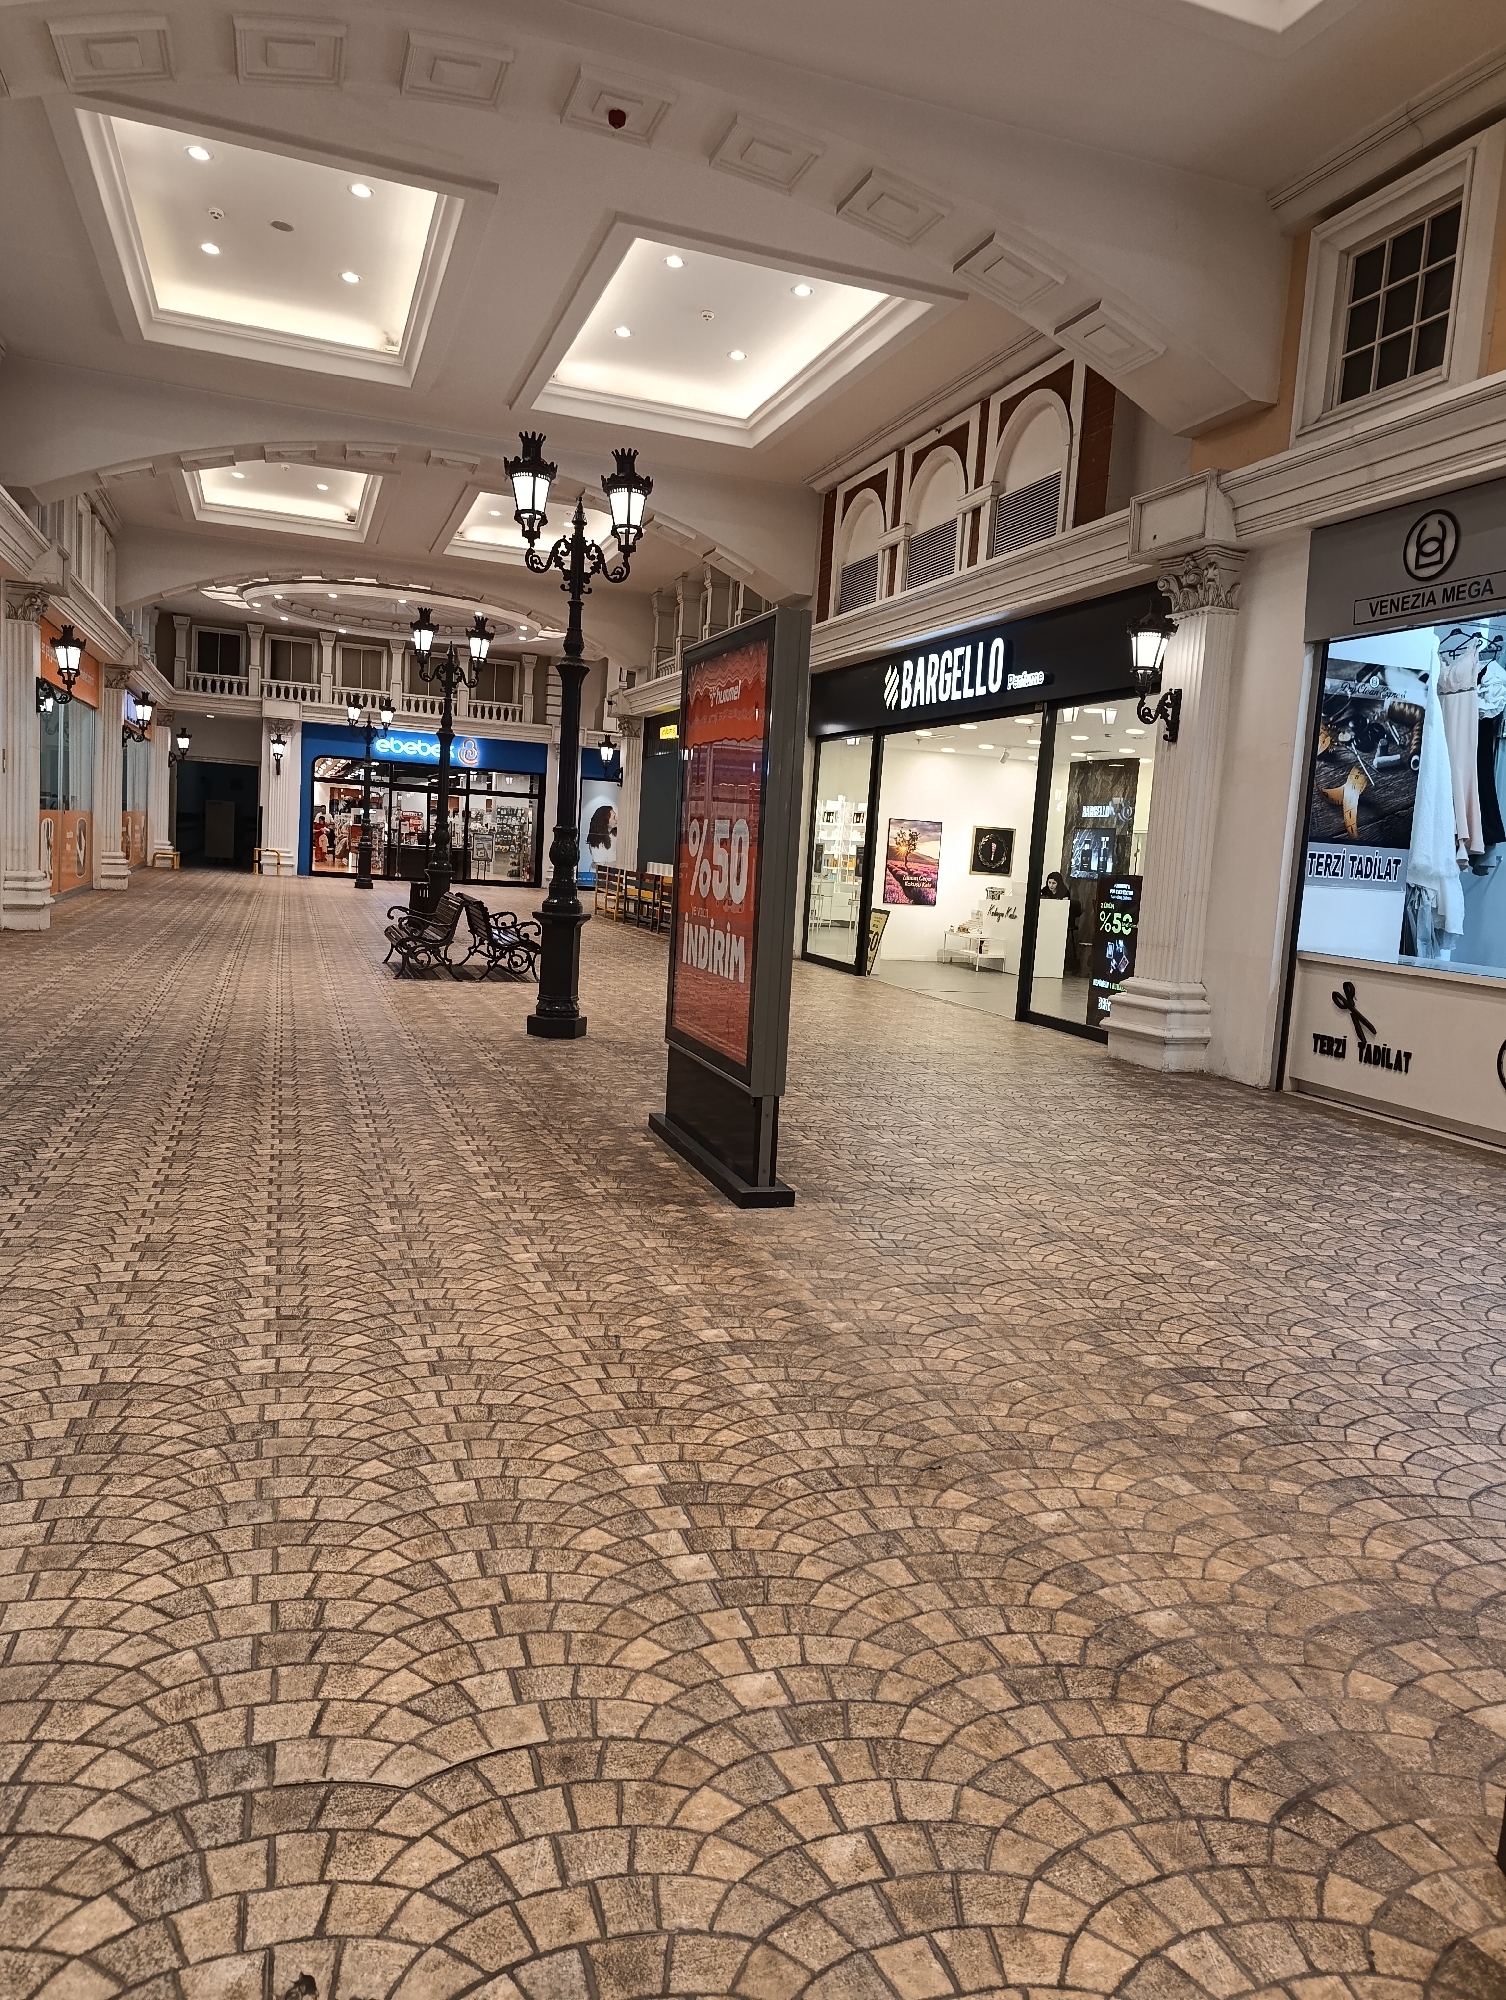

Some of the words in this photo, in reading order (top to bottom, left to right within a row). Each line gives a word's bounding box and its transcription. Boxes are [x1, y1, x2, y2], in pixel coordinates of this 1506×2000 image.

[1369, 591, 1436, 617] VENEZIA
[1441, 578, 1494, 604] MEGA
[900, 637, 1004, 710] BARGELLO
[1007, 671, 1044, 691] Perfume
[1341, 682, 1356, 697] Dry
[1357, 684, 1379, 697] Clean
[688, 818, 750, 905] %50
[1307, 848, 1347, 880] TERZİ
[1349, 850, 1403, 882] TADİLAT
[683, 912, 745, 983] İNDİRİM
[1313, 1033, 1347, 1059] TERZİ
[1357, 1042, 1412, 1074] TADİLAT
